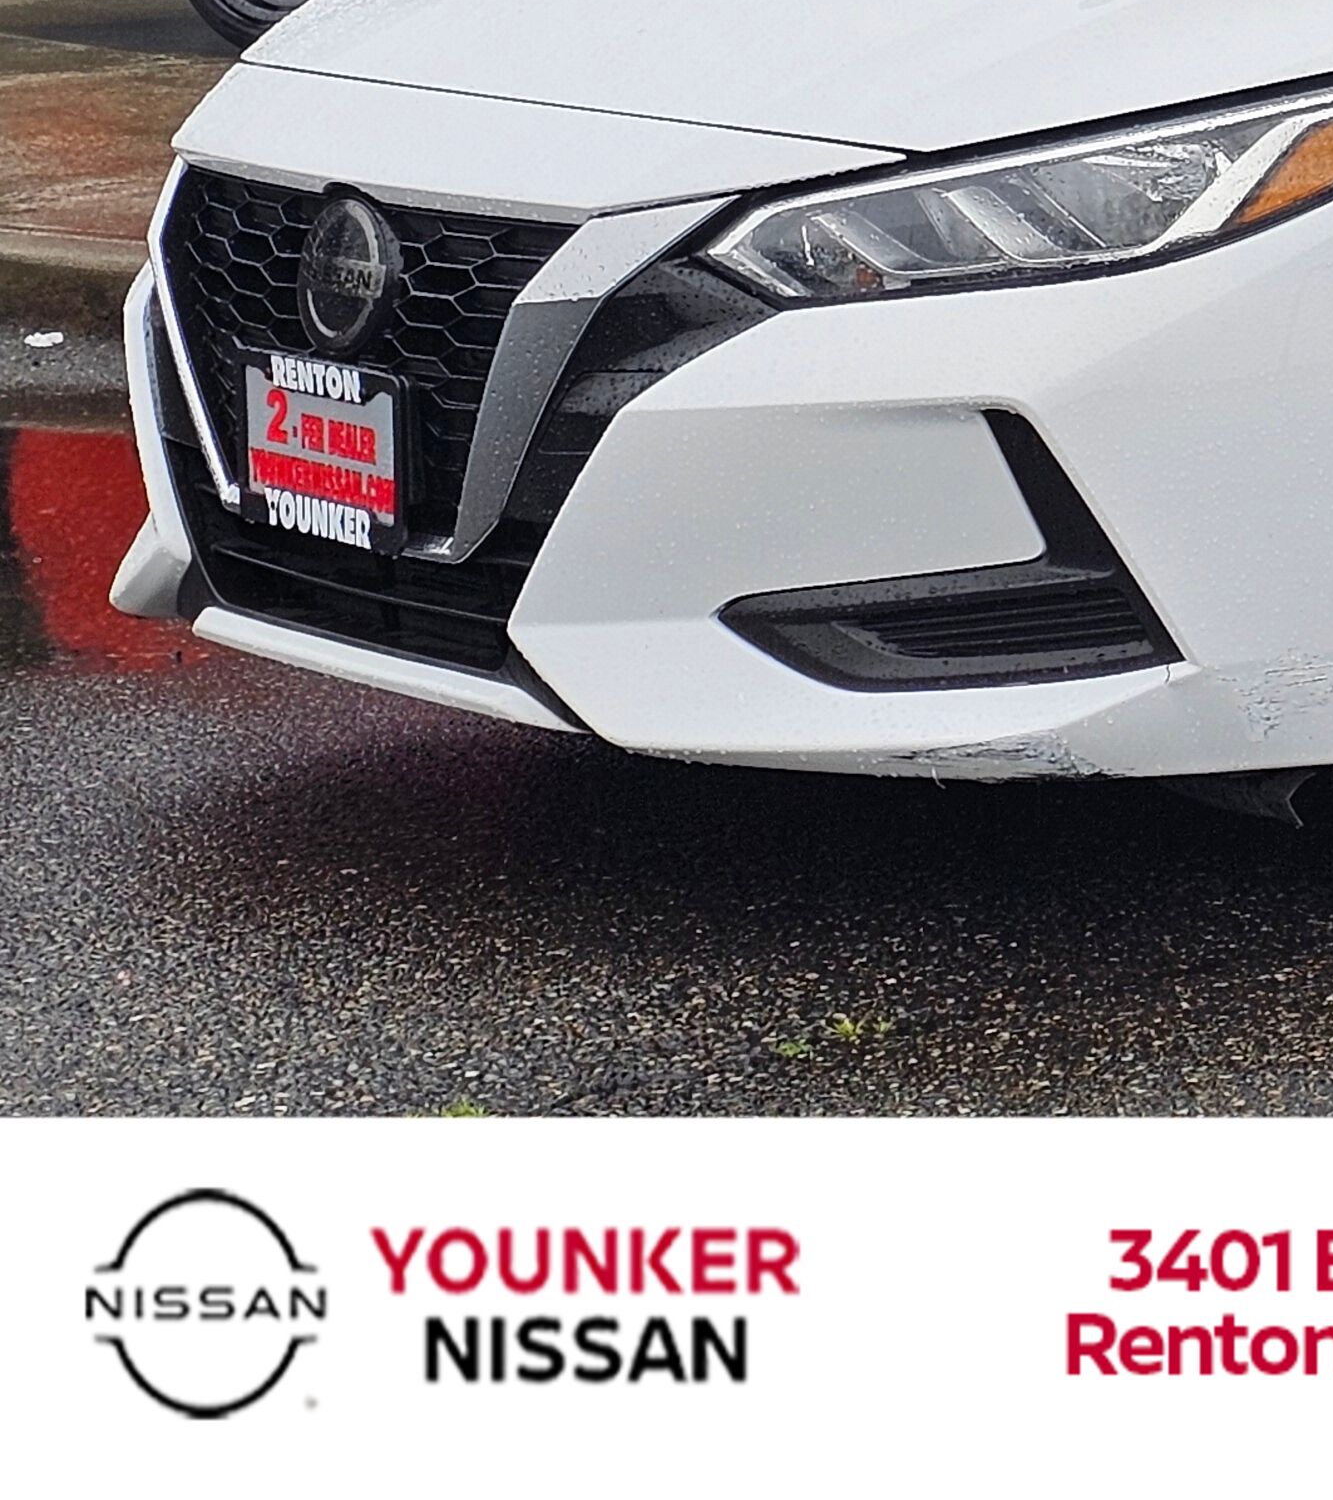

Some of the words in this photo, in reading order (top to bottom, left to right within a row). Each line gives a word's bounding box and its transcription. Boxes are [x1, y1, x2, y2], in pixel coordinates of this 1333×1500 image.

[270, 354, 362, 403] RENTON
[267, 389, 289, 445] 2
[264, 487, 372, 550] YOUNKER
